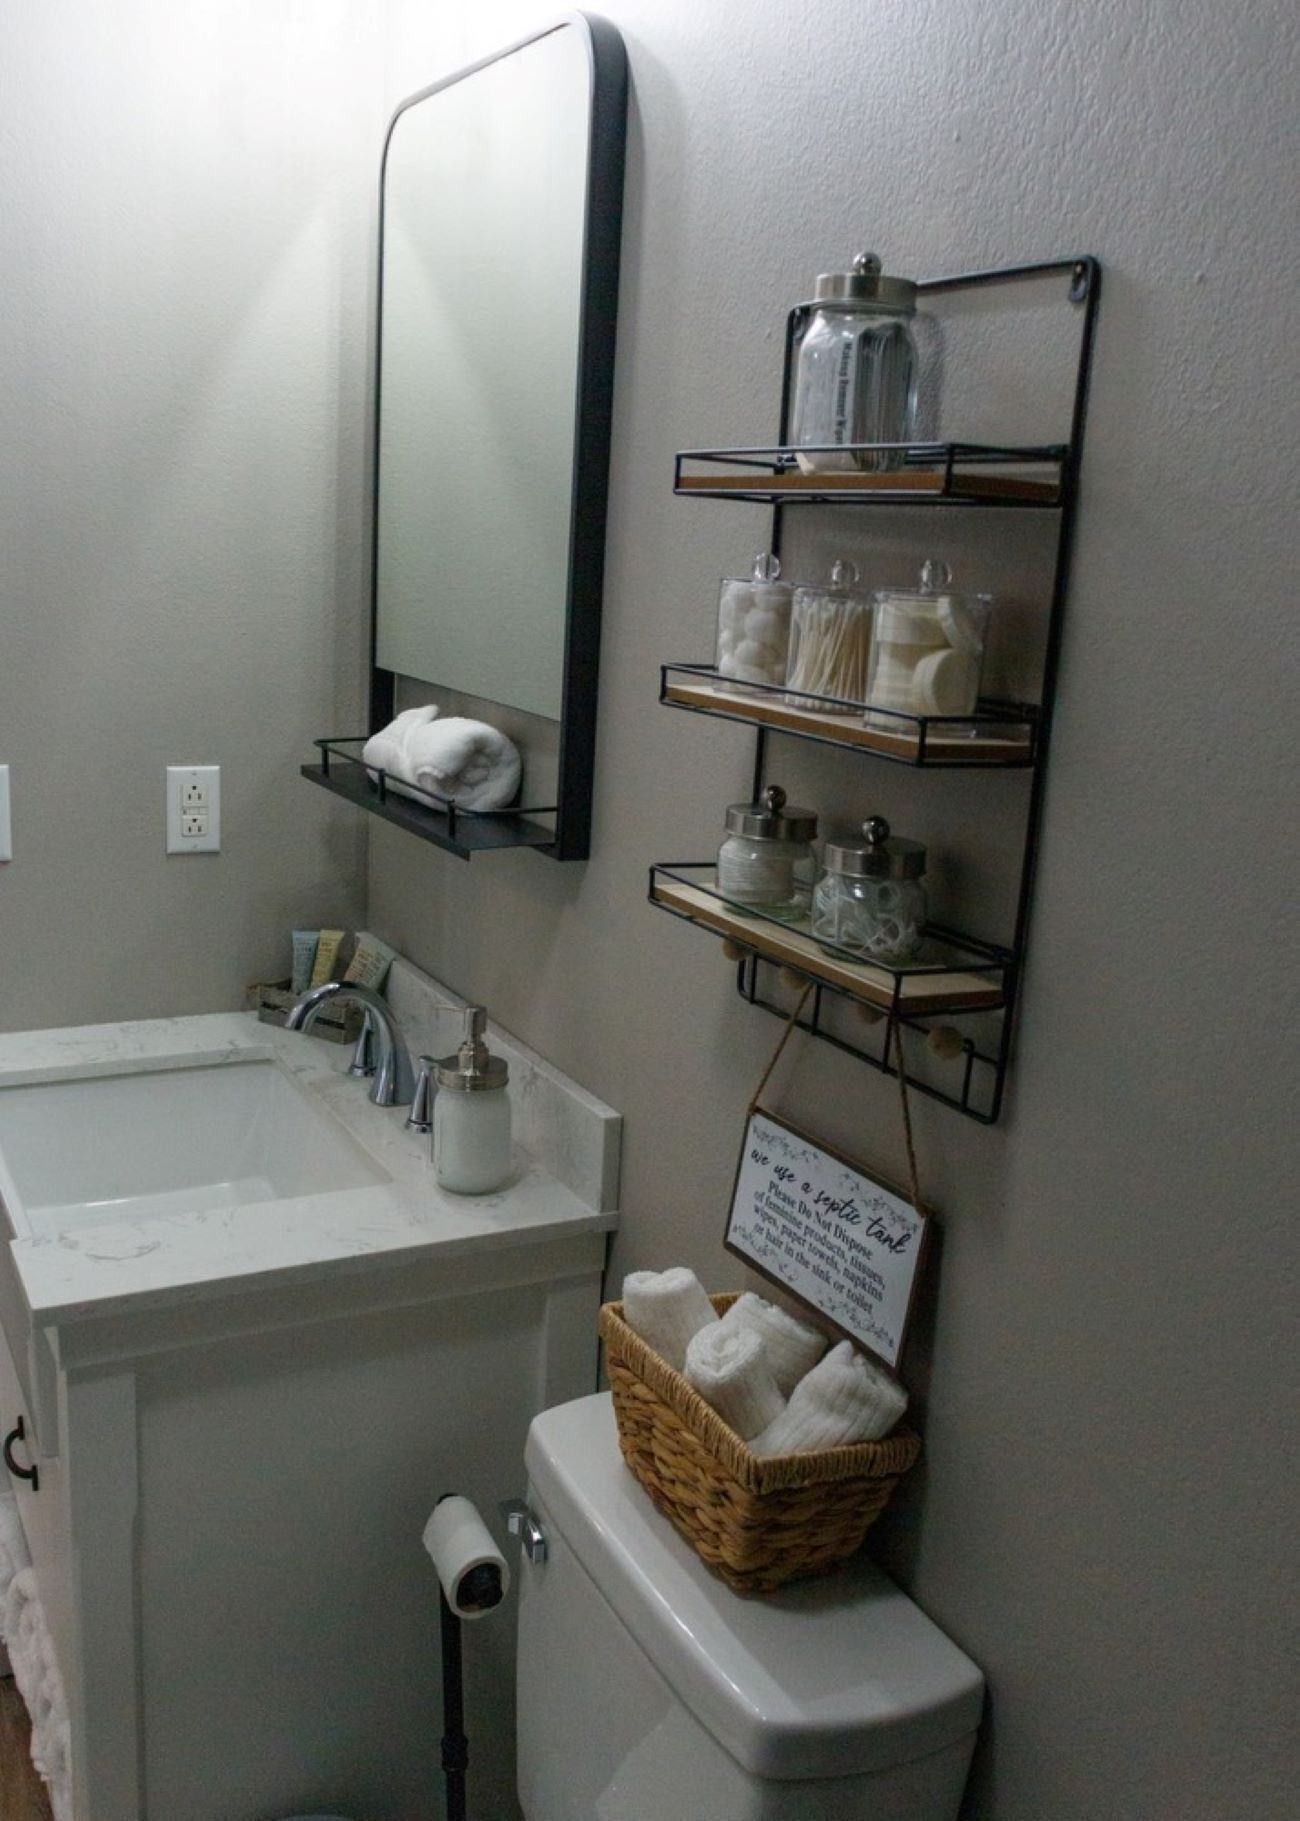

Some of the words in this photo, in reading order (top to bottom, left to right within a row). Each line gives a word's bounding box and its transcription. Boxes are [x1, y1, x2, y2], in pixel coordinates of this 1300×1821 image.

[750, 1149, 770, 1166] we
[773, 1165, 797, 1181] use
[801, 1182, 814, 1194] a
[813, 1190, 862, 1225] septic
[865, 1215, 912, 1254] tank
[753, 1191, 766, 1202] of
[765, 1195, 803, 1229] feminine
[803, 1225, 848, 1263] products,
[850, 1255, 886, 1290] tissues,
[768, 1180, 796, 1208] Please
[798, 1200, 812, 1219] Do
[815, 1210, 833, 1232] Not
[833, 1225, 873, 1260] Dispose
[753, 1204, 780, 1230] wipes,
[780, 1224, 806, 1247] paper
[807, 1242, 841, 1274] towels,
[842, 1267, 883, 1302] napkins
[754, 1223, 765, 1234] or
[765, 1228, 783, 1249] hair
[784, 1243, 795, 1257] in
[795, 1251, 811, 1269] the
[811, 1264, 832, 1285] sink
[833, 1280, 845, 1294] or
